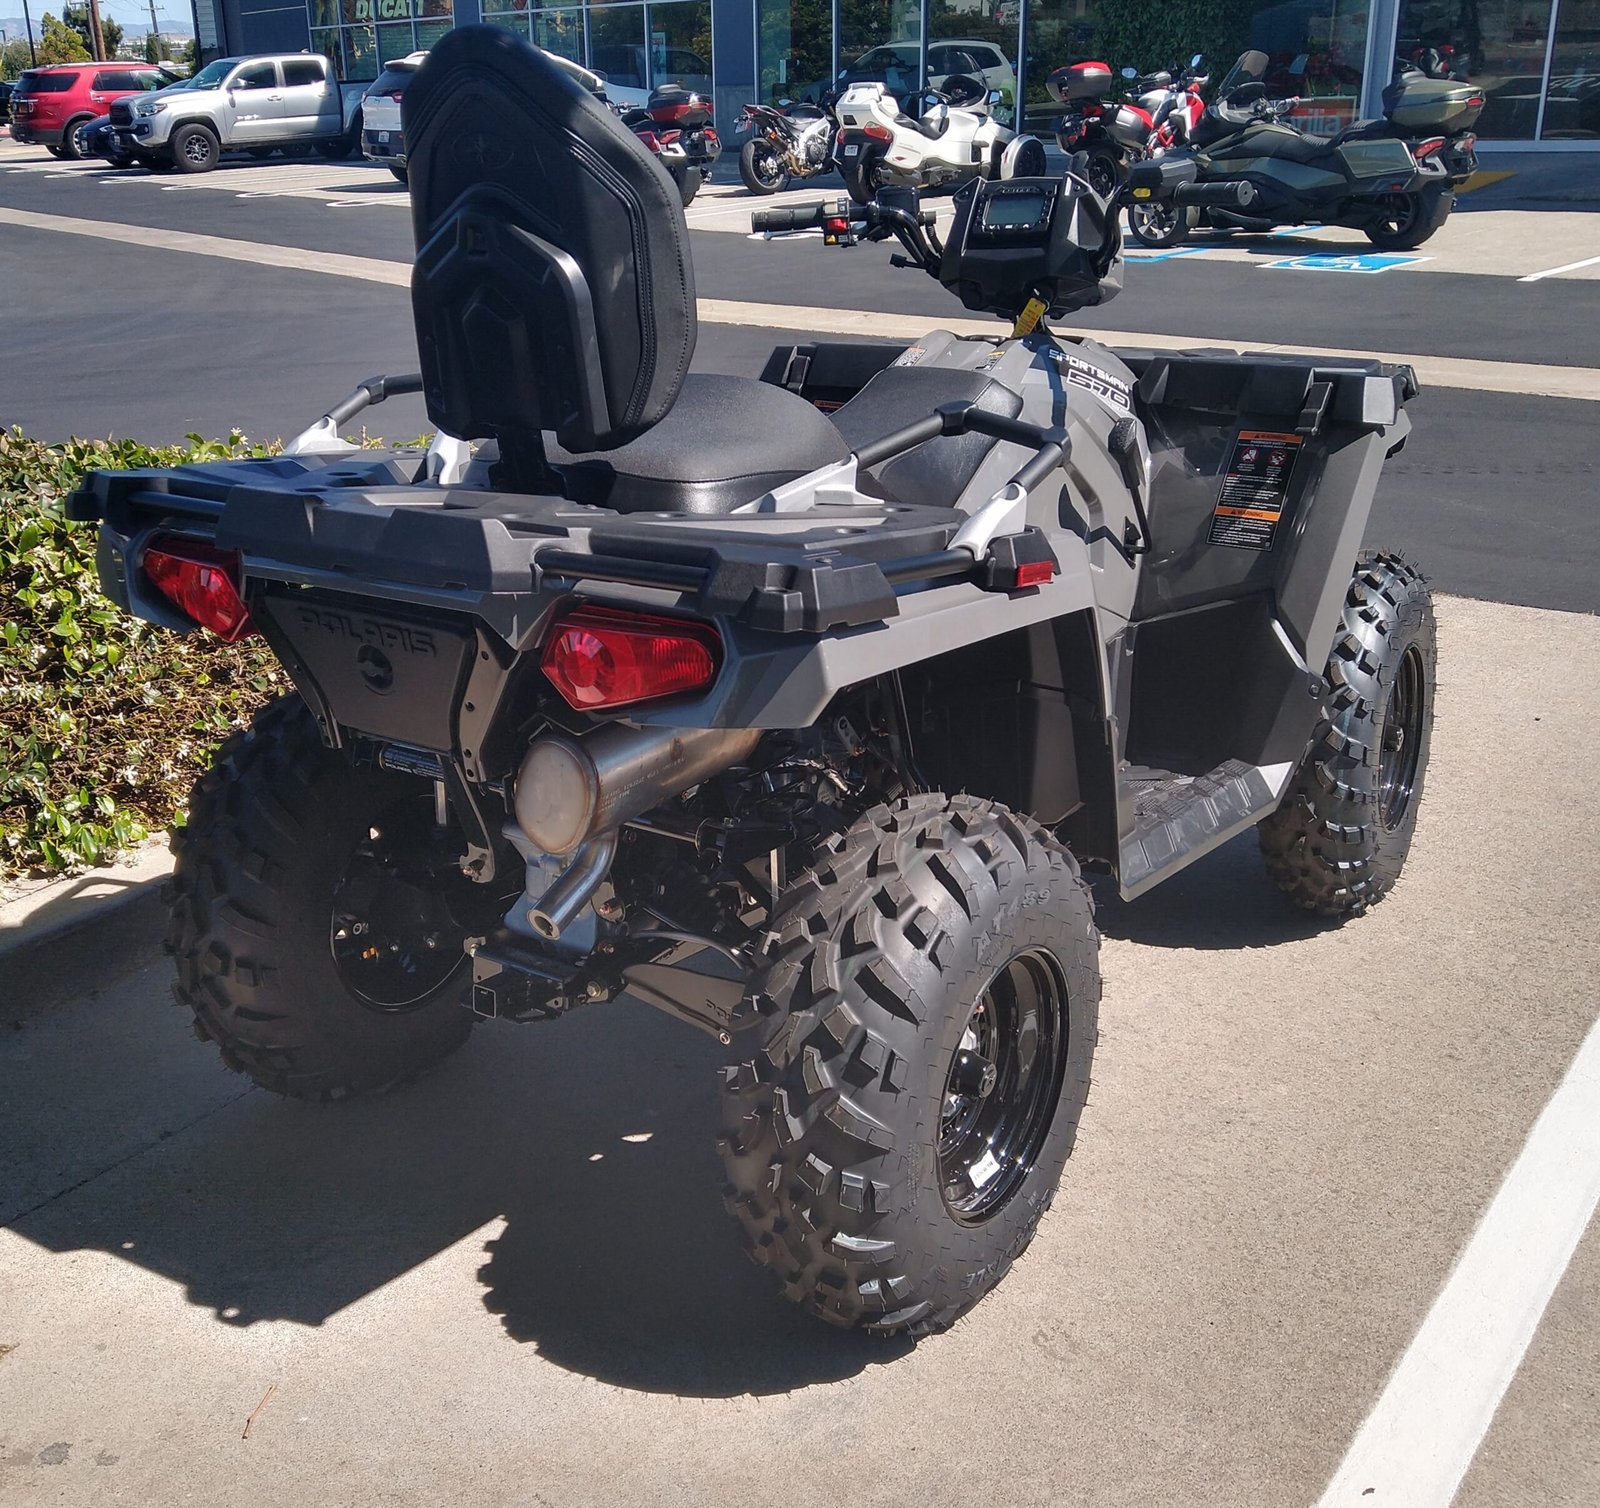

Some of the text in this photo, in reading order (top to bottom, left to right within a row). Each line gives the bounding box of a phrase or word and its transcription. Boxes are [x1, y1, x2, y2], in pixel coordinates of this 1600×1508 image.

[1048, 348, 1130, 394] SPORTSMAN
[1066, 368, 1131, 412] 570
[298, 606, 438, 658] POLARIS
